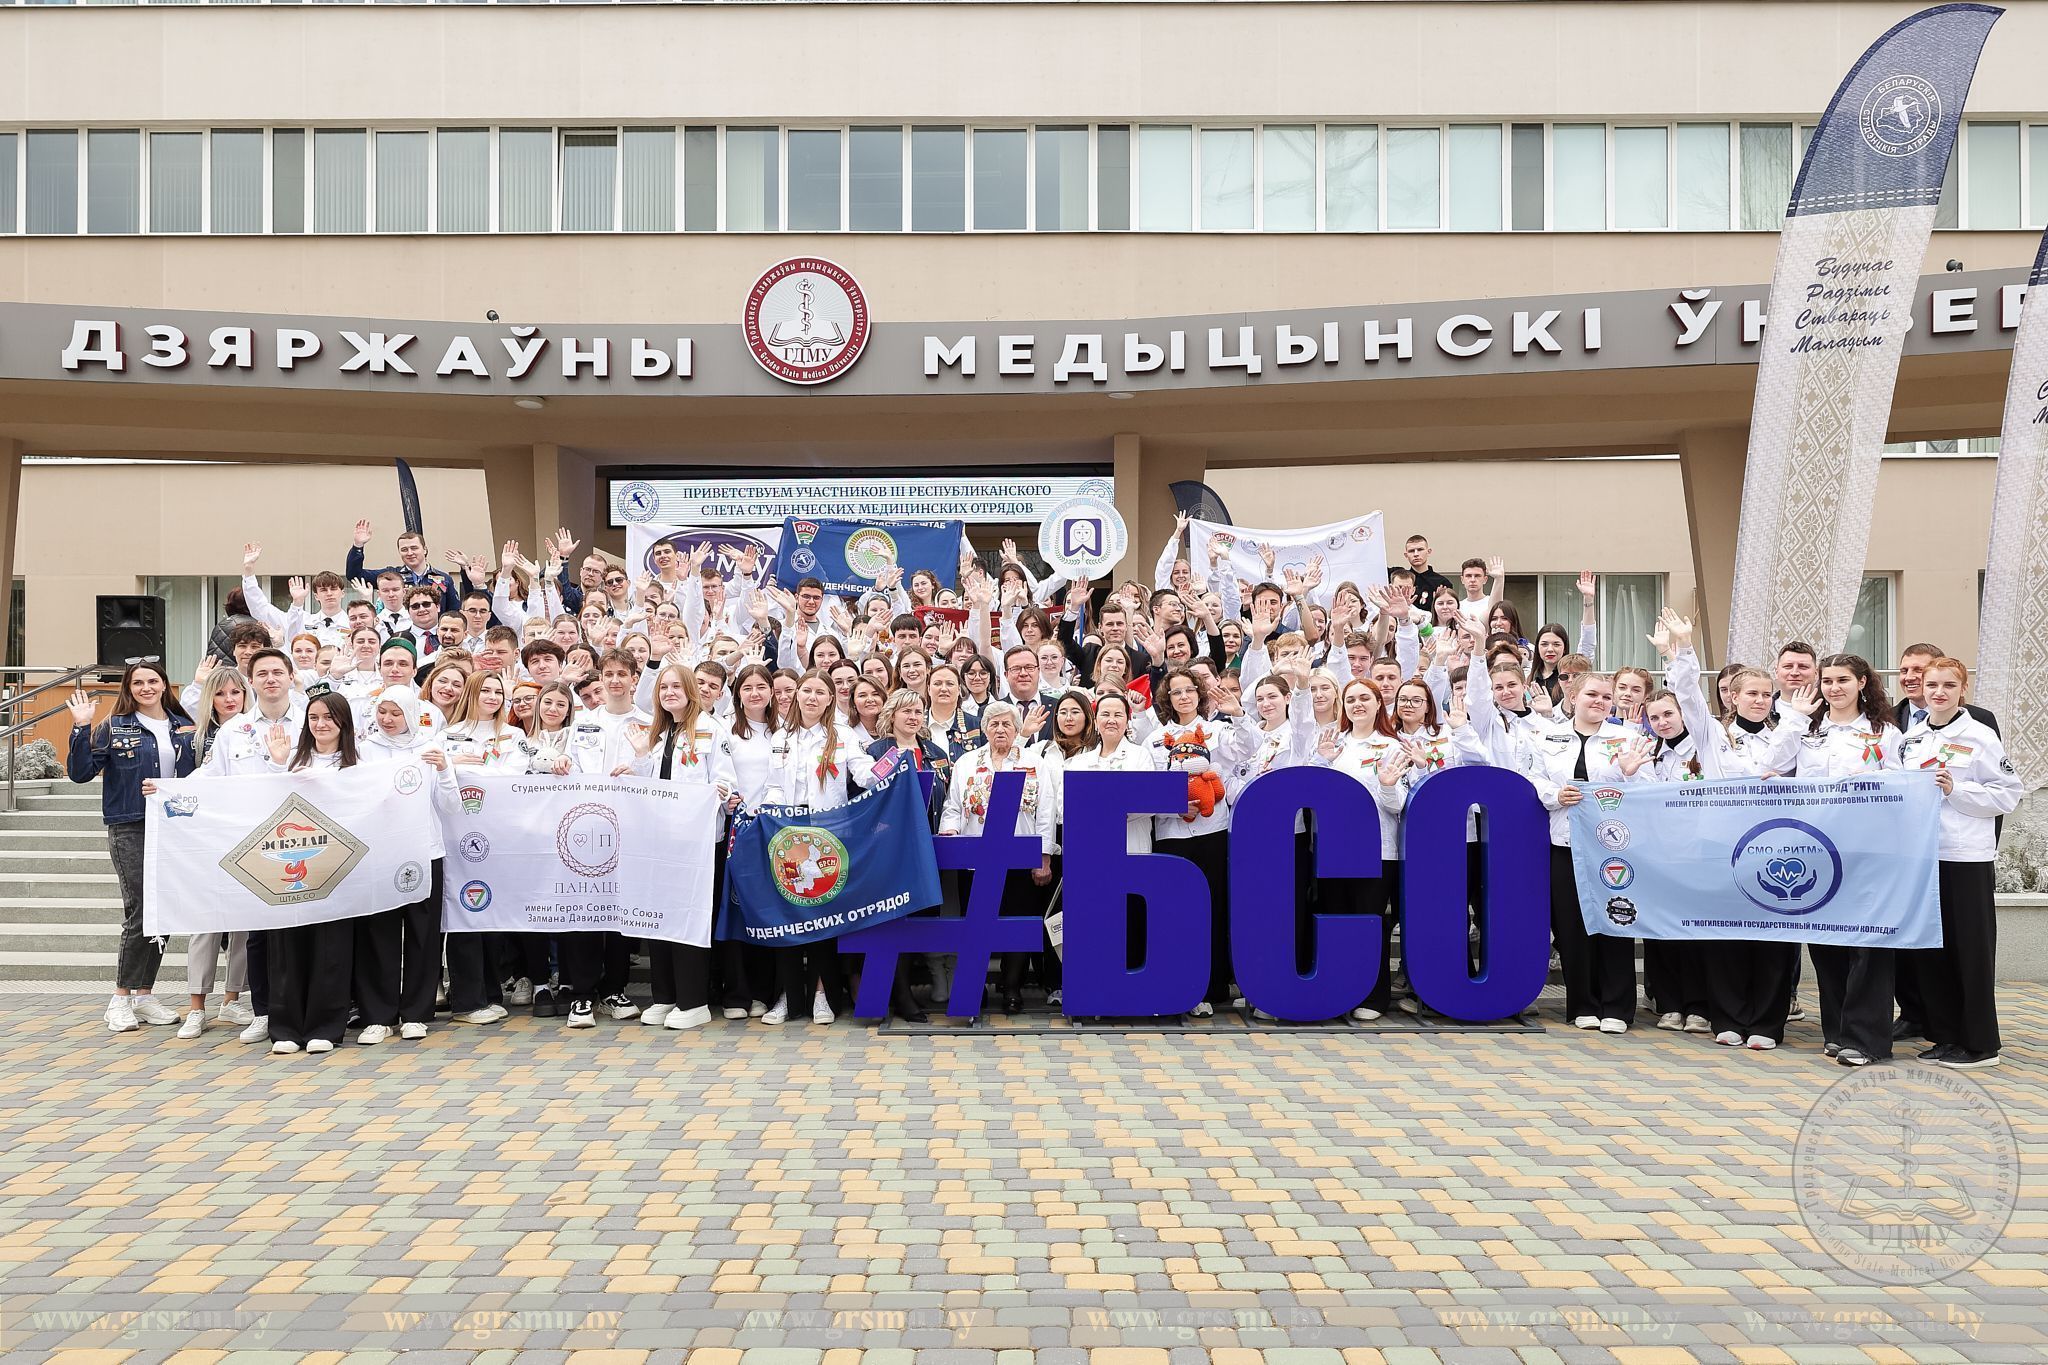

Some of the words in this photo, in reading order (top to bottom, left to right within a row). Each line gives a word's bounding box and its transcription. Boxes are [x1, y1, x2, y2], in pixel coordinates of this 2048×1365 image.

[1877, 79, 1936, 102] БЕЛАРУСКІЯ
[1863, 109, 1897, 153] СТУДЭНЦКІЯ
[1907, 121, 1937, 152] АТРАДЫ
[1815, 257, 1894, 280] Будучае
[1806, 283, 1892, 305] Радзімы
[1795, 306, 1890, 330] Ствараць
[61, 319, 696, 380] ДЗЯРЖАЎНЫ
[923, 307, 1603, 384] МЕДЫЦЫНСКІ
[1790, 335, 1884, 354] Маладым
[783, 347, 833, 366] ГДМУ
[781, 368, 800, 379] State
[683, 488, 792, 499] ПРИВЕТСТВУЕМ
[796, 487, 887, 498] УЧАСТНИКОВ
[890, 486, 907, 496] III
[909, 485, 1052, 497] РЕСПУБЛИКАНСКОГО
[701, 505, 745, 516] СЛЕТА
[747, 504, 855, 517] СТУДЕНЧЕСКИХ
[858, 503, 967, 516] МЕДИЦИНСКИХ
[970, 502, 1034, 514] ОТРЯДОВ
[796, 524, 816, 534] БРСМ
[461, 790, 481, 800] БРСМ
[511, 782, 581, 794] Студенческий
[584, 783, 648, 796] медицинский
[651, 789, 679, 800] отряд
[1680, 784, 1746, 796] СТУДЕНЧЕСКИЙ
[1748, 783, 1816, 795] МЕДИЦИНСКИЙ
[1818, 783, 1848, 793] ОТРЯД
[1850, 781, 1885, 791] "РИТМ"
[1665, 800, 1688, 808] ИМЕНИ
[1709, 798, 1782, 808] СОЦИАЛИСТИЧЕСКОГО
[1784, 798, 1805, 806] ТРУДА
[1821, 796, 1868, 805] ПРОХОРОВНЫ
[1870, 794, 1904, 803] ТИТОВОЙ
[1747, 846, 1773, 854] СМО
[1777, 845, 1823, 854] «РИТМ»
[818, 860, 836, 868] БРСМ
[554, 881, 620, 894] ПАНАЦЕ
[776, 882, 823, 905] ГРОДНЕНСКАЯ
[837, 765, 1552, 1022] #БСО
[279, 894, 301, 903] ШТАБ
[303, 892, 316, 900] СО
[525, 904, 552, 912] имени
[555, 903, 583, 913] Героя
[632, 907, 664, 919] Союза
[528, 913, 566, 923] Залмана
[746, 913, 844, 940] ТУДЕНЧЕСКИХ
[847, 892, 911, 922] ОТРЯДОВ
[1691, 919, 1743, 928] "МОГИЛЕВСКИЙ
[1744, 920, 1811, 930] ГОСУДАРСТВЕННЫЙ
[1811, 922, 1859, 932] МЕДИЦИНСКИЙ
[1860, 924, 1899, 935] КОЛЛЕДЖ"
